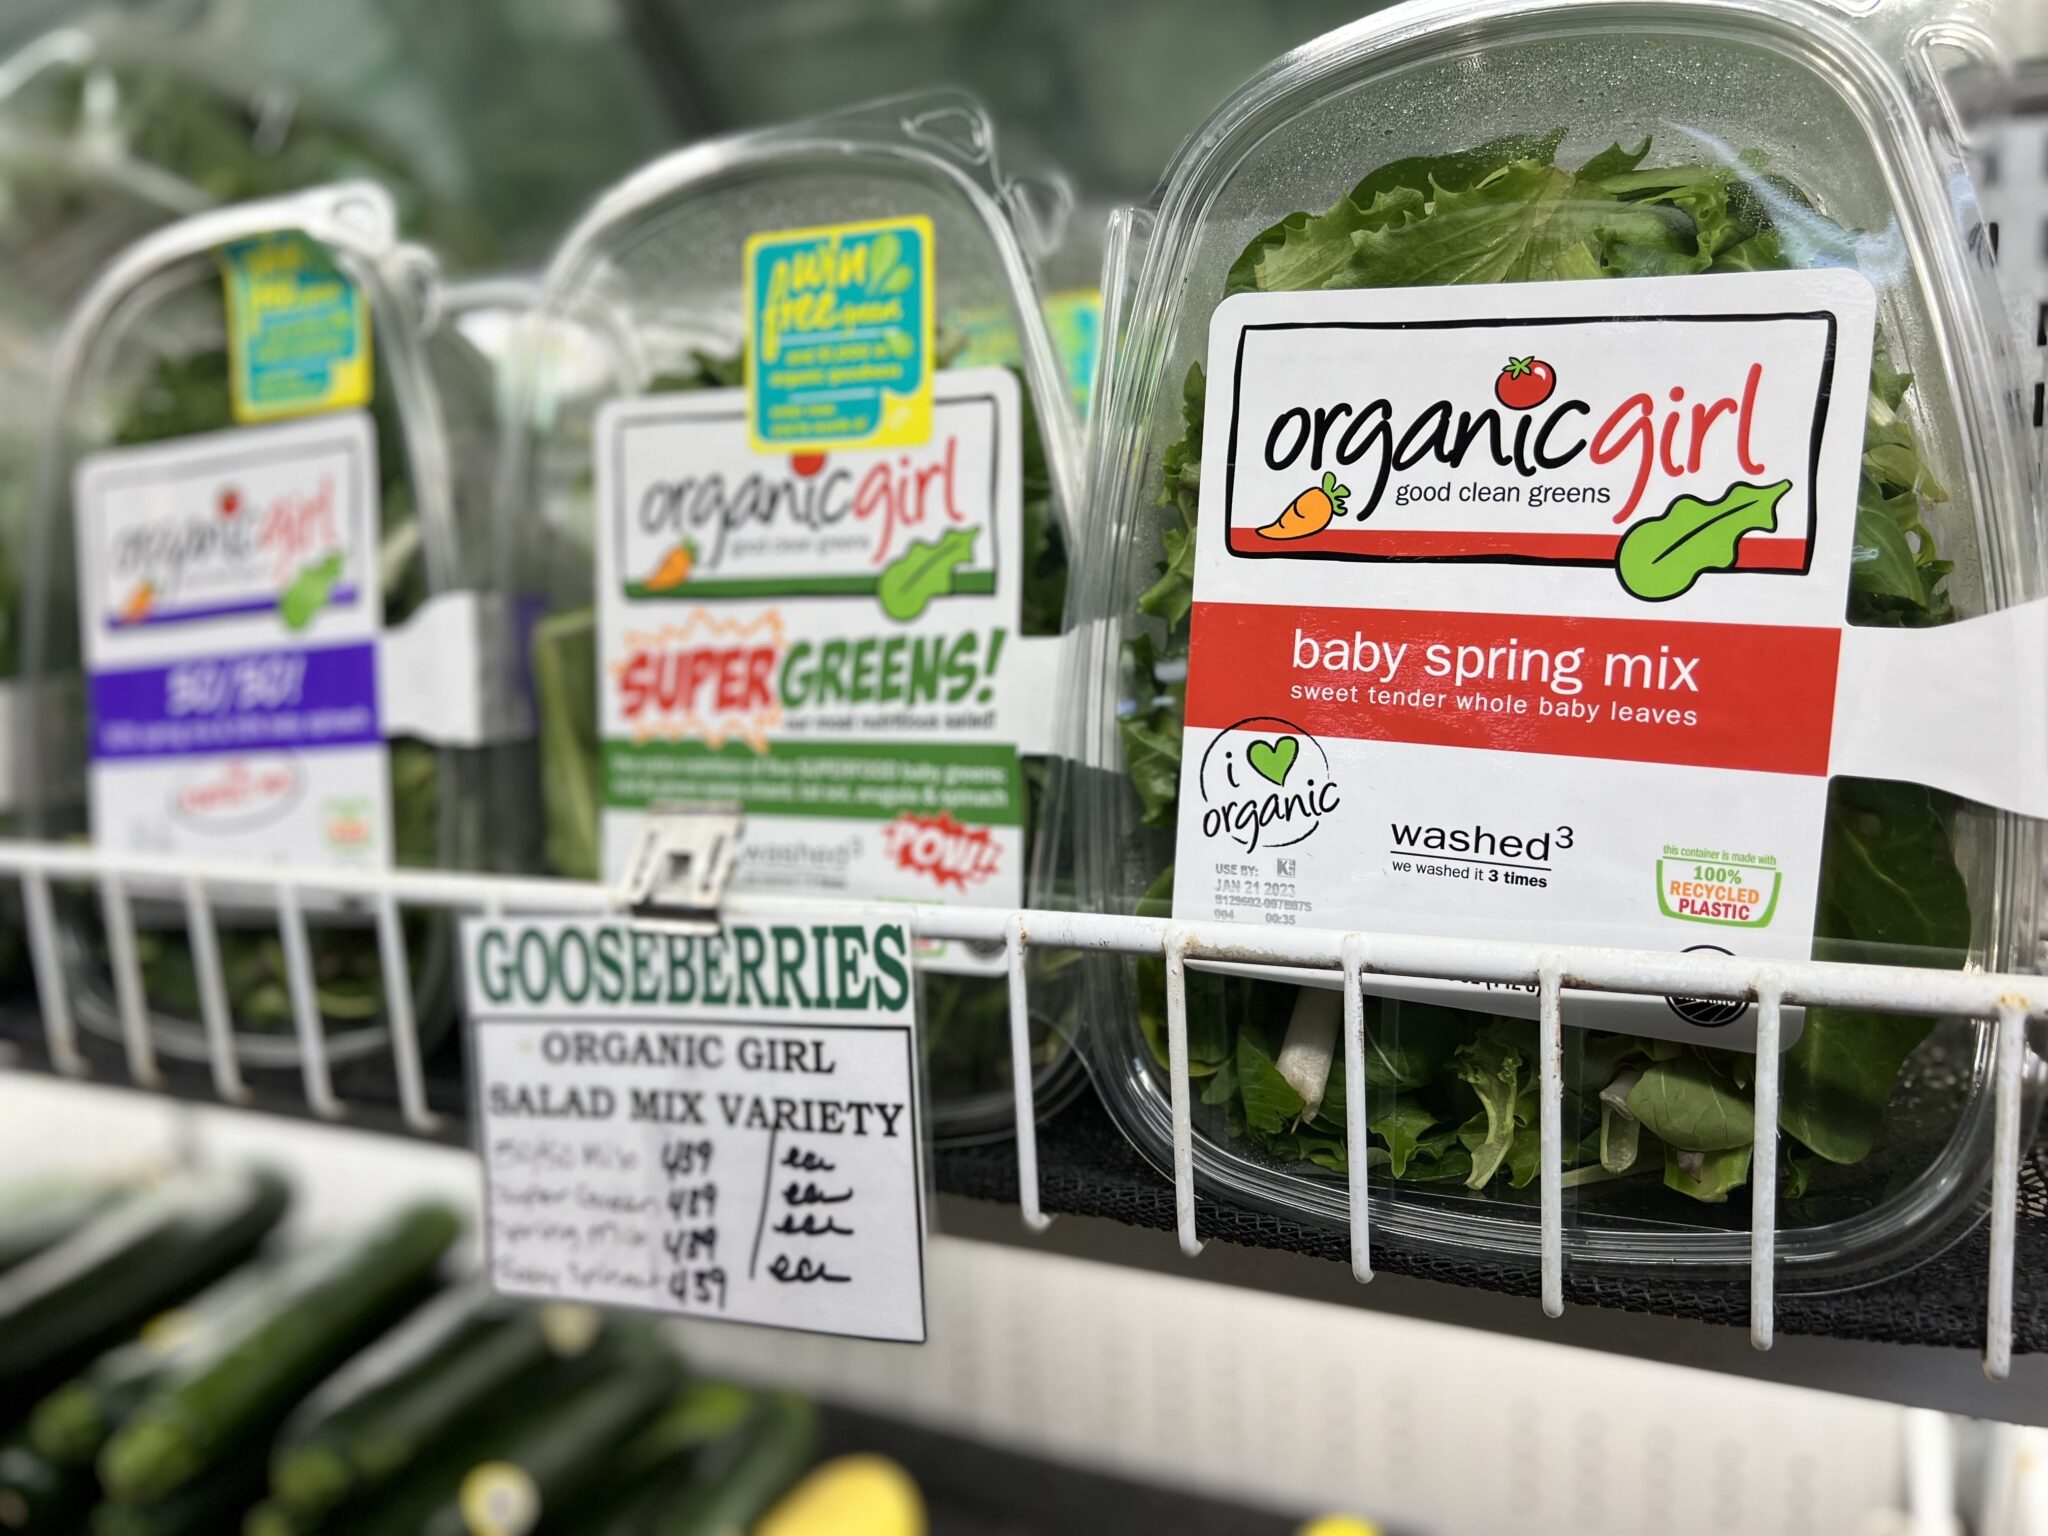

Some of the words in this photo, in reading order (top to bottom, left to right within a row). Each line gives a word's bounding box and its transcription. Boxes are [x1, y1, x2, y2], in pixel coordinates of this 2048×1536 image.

[1264, 362, 1764, 525] organicgirl
[1395, 482, 1451, 506] good
[1458, 482, 1520, 503] clean
[1527, 484, 1611, 508] greens
[618, 646, 777, 719] SUPER
[778, 628, 1007, 709] GREENS!
[1291, 628, 1408, 684] baby
[1423, 637, 1586, 695] spring
[1603, 645, 1701, 692] mix
[1290, 684, 1359, 702] sweet
[1367, 687, 1448, 709] tender
[1456, 694, 1528, 715] whole
[1538, 697, 1601, 724] baby
[1610, 701, 1699, 726] leaves
[1225, 751, 1240, 788] i
[1203, 779, 1340, 854] organic
[1215, 863, 1238, 876] USE
[1240, 865, 1259, 877] BY:
[1663, 844, 1679, 856] this
[1680, 846, 1720, 860] container
[1721, 849, 1730, 861] is
[1731, 852, 1757, 864] made
[1757, 854, 1777, 866] with
[1214, 879, 1241, 893] JAN
[1244, 880, 1260, 894] 21
[1264, 881, 1296, 898] 2023
[1391, 861, 1412, 873] we
[1415, 863, 1470, 880] washed
[1474, 868, 1485, 882] it
[1487, 869, 1499, 882] 3
[1503, 871, 1548, 888] times
[1669, 879, 1760, 905] RECYCLED
[1693, 865, 1743, 885] 100%
[1678, 898, 1750, 921] PLASTIC
[476, 923, 911, 1013] GOOSEBERRIES
[539, 1029, 725, 1071] ORGANIC
[736, 1036, 836, 1075] GIRL
[487, 1081, 616, 1122] SALAD
[628, 1085, 706, 1126] MIX
[720, 1095, 906, 1139] VARIETY
